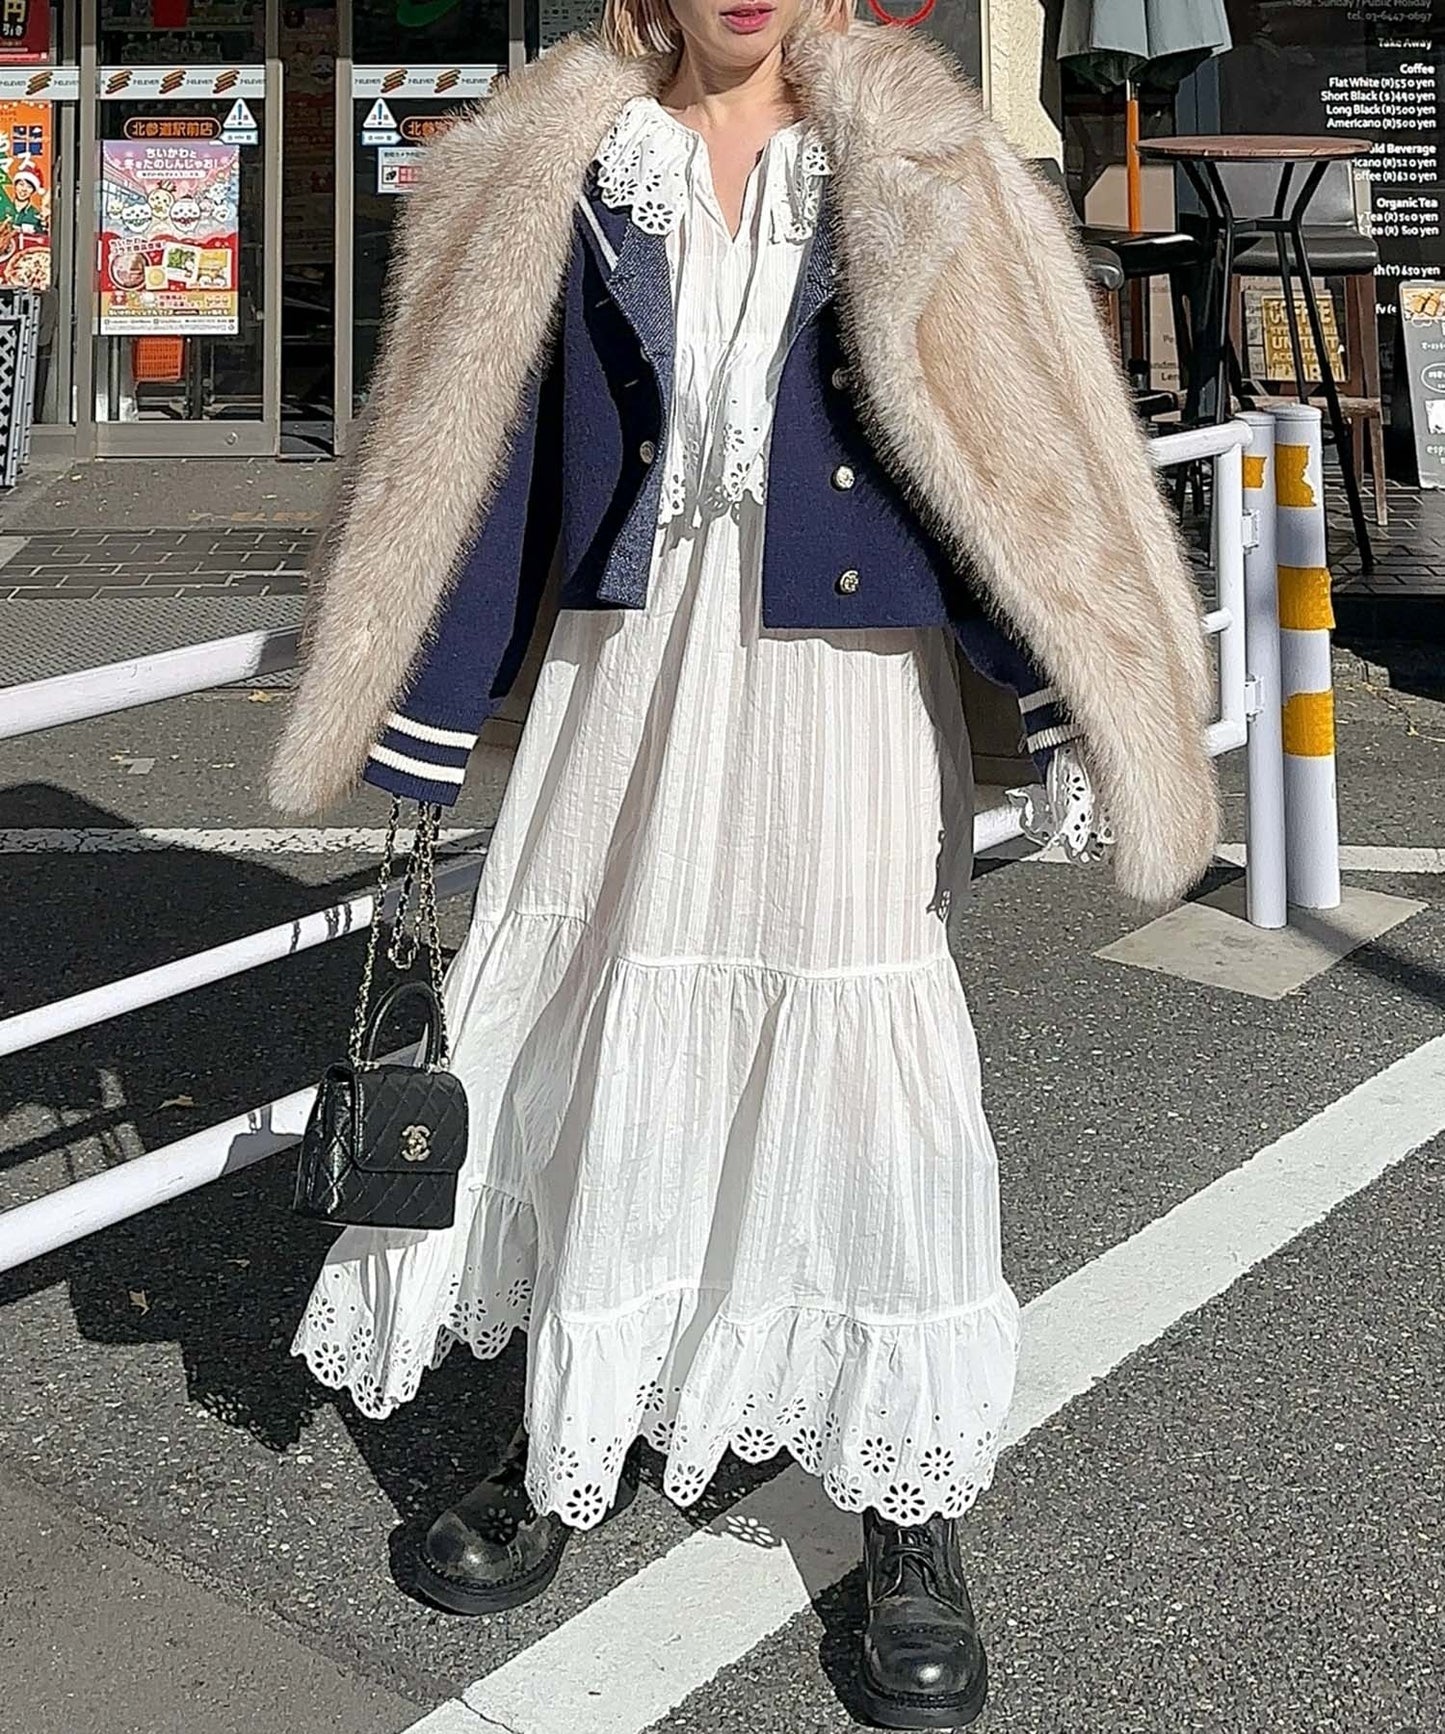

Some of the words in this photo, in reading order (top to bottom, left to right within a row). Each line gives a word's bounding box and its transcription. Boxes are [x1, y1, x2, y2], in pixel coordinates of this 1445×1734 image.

[1378, 38, 1402, 48] Take
[1403, 38, 1433, 50] Away
[1399, 63, 1436, 75] Coffee
[1328, 77, 1349, 88] Flat
[1350, 77, 1380, 88] White
[1320, 91, 1350, 102] Short
[1350, 91, 1378, 101] Black
[1326, 104, 1352, 117] Long
[1353, 104, 1380, 115] Black
[1326, 117, 1381, 129] Americano
[1387, 143, 1437, 156] Beverage
[1376, 197, 1418, 210] Organic
[1418, 197, 1438, 208] Tea
